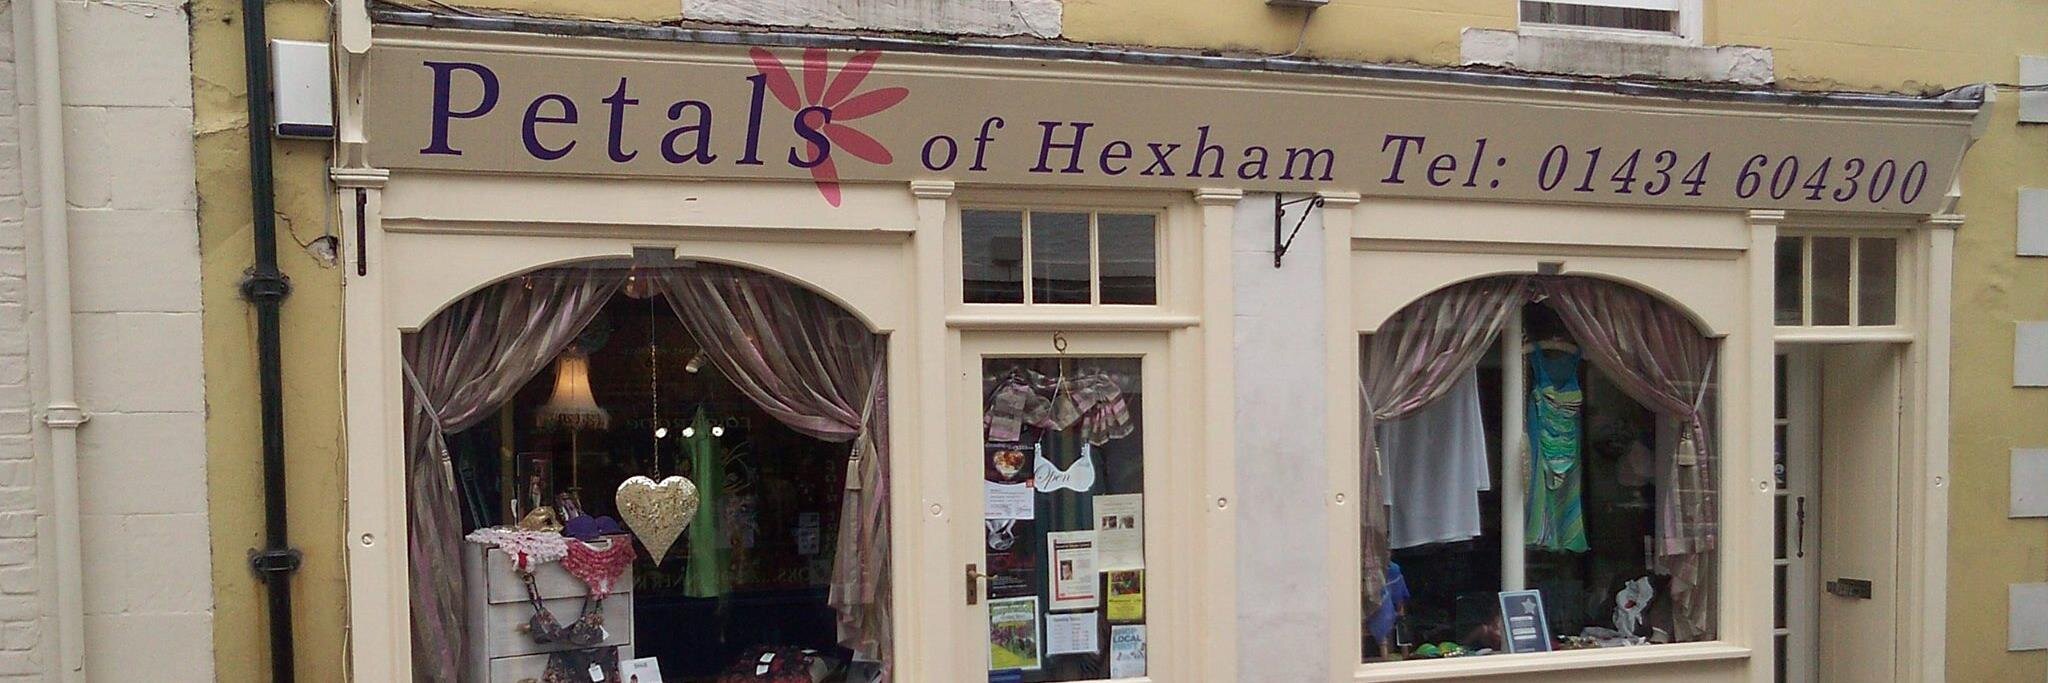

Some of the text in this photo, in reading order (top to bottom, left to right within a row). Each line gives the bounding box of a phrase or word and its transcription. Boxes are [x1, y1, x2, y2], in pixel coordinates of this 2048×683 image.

[420, 61, 1928, 204] Petals of Hexham Tel: 01434 604300
[1034, 464, 1072, 490] Open
[1113, 634, 1142, 643] LOCAL
